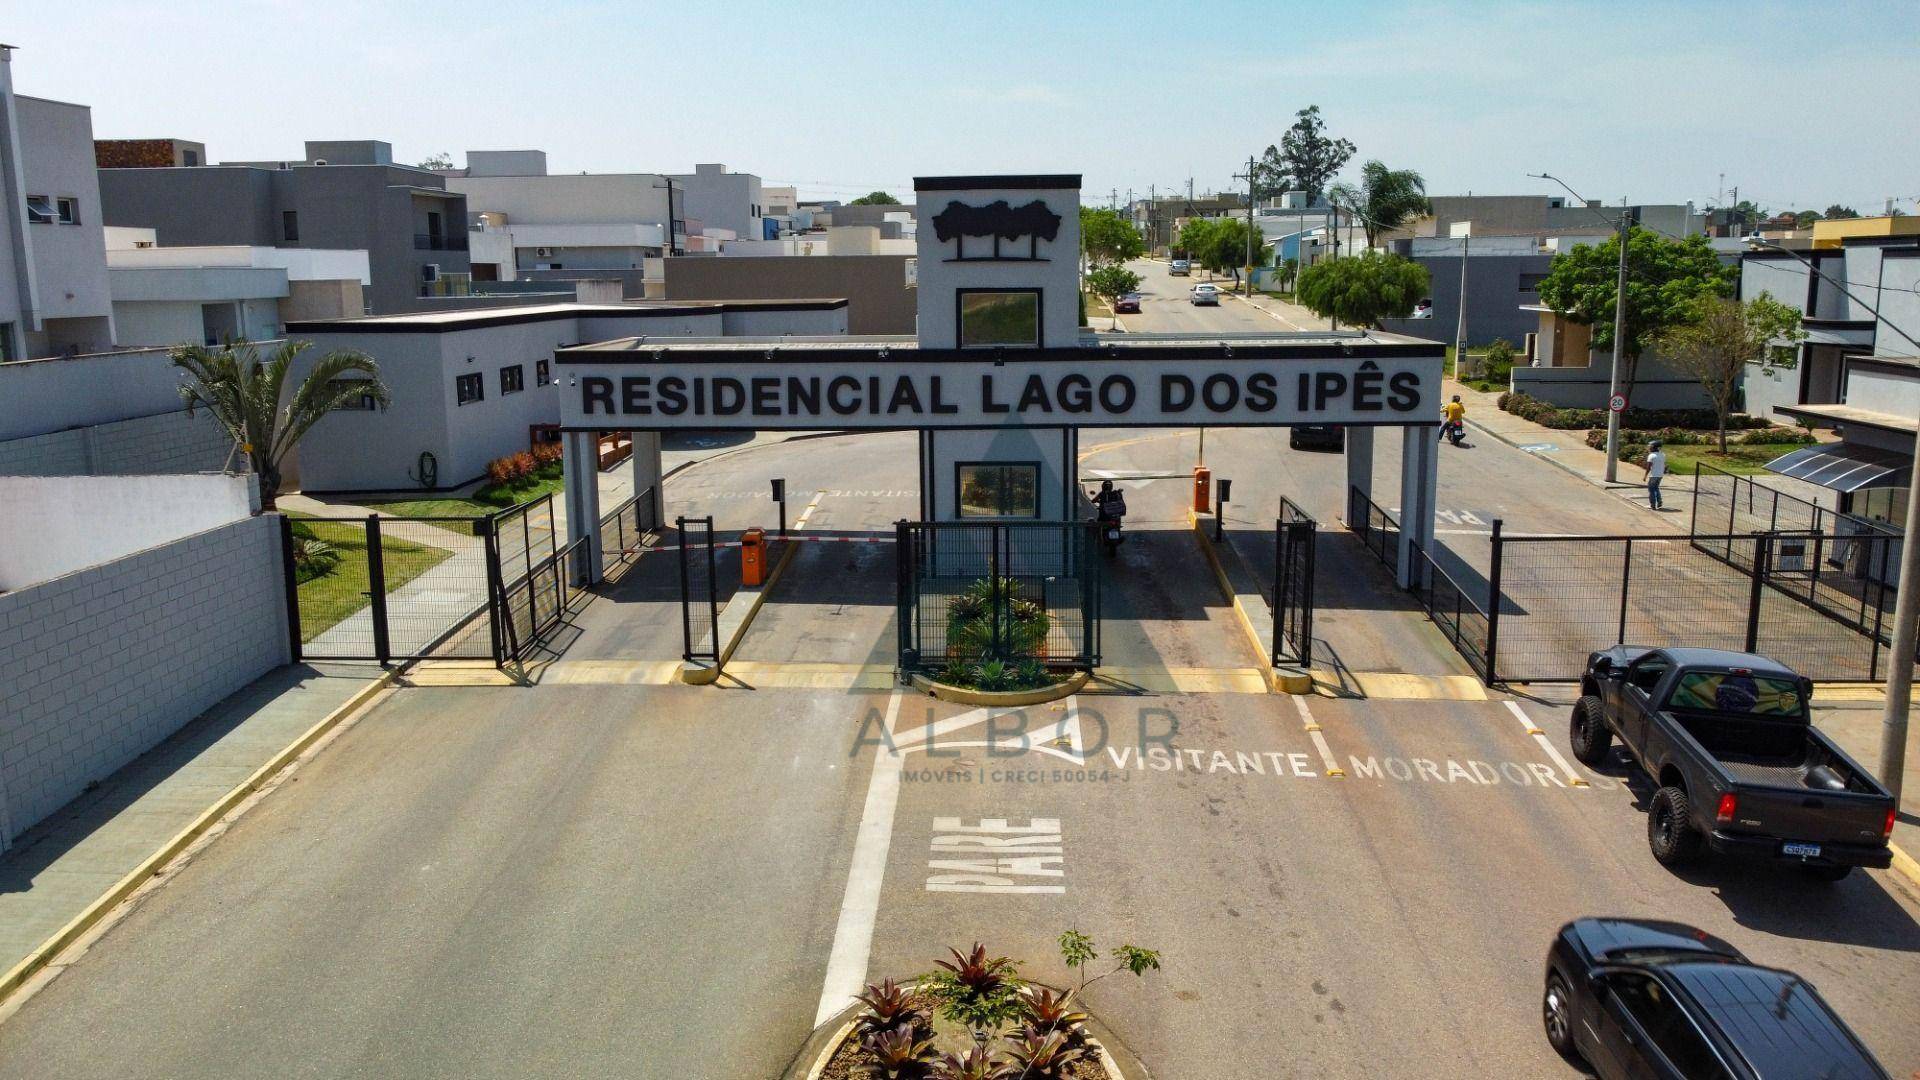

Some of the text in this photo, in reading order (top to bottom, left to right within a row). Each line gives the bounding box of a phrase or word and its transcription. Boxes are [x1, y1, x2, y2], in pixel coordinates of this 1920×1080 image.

[582, 360, 1422, 416] RESIDENCIAL LAGO DOS IPÊS
[1612, 398, 1623, 407] 20
[706, 490, 815, 499] MOADOR
[829, 489, 921, 498] ISITANTE
[1106, 746, 1318, 778] VISITANTE
[1348, 754, 1568, 788] MORADOR
[925, 816, 1066, 894] PARE
